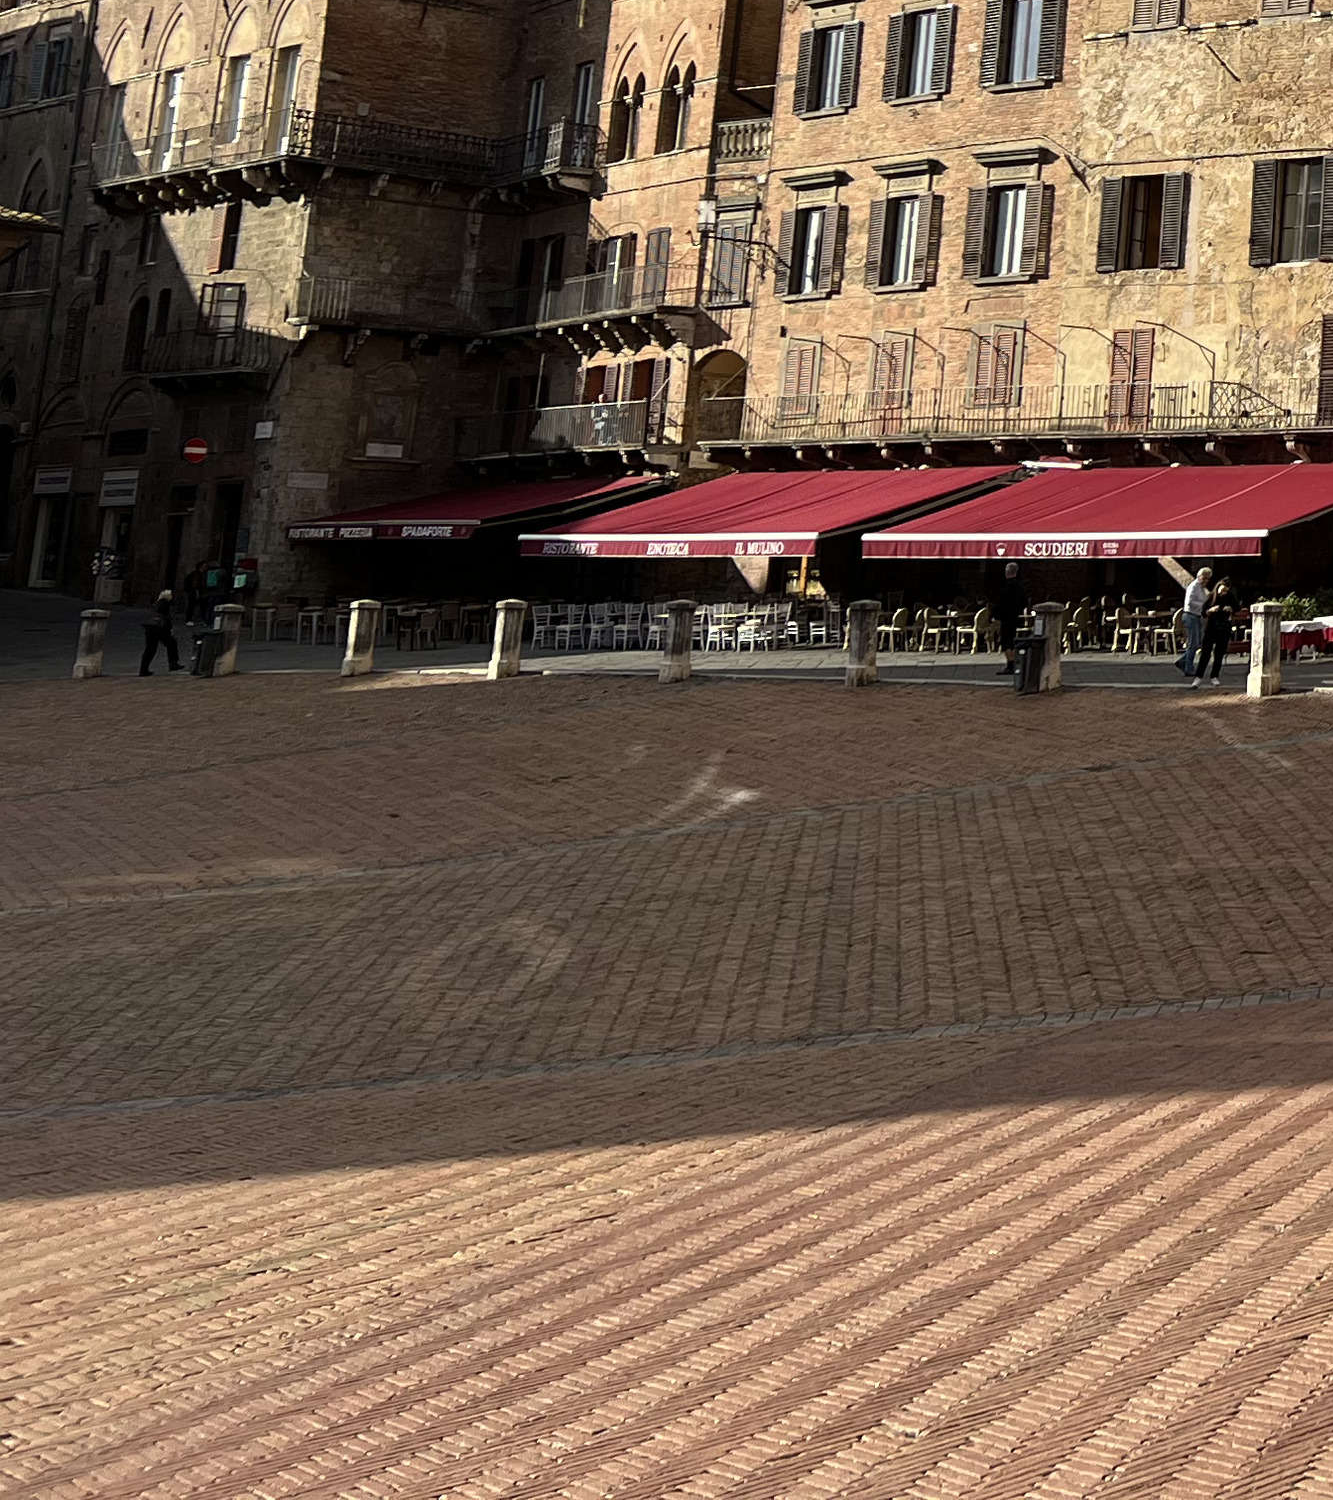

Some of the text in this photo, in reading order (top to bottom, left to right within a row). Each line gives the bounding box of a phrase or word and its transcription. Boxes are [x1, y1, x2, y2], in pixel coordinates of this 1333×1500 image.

[288, 527, 335, 539] RISTORANTE
[339, 527, 373, 539] PIZZERIA
[542, 541, 785, 555] RISTORANTE ENOTECA IL MULINO
[1024, 542, 1089, 556] SCUDIERI
